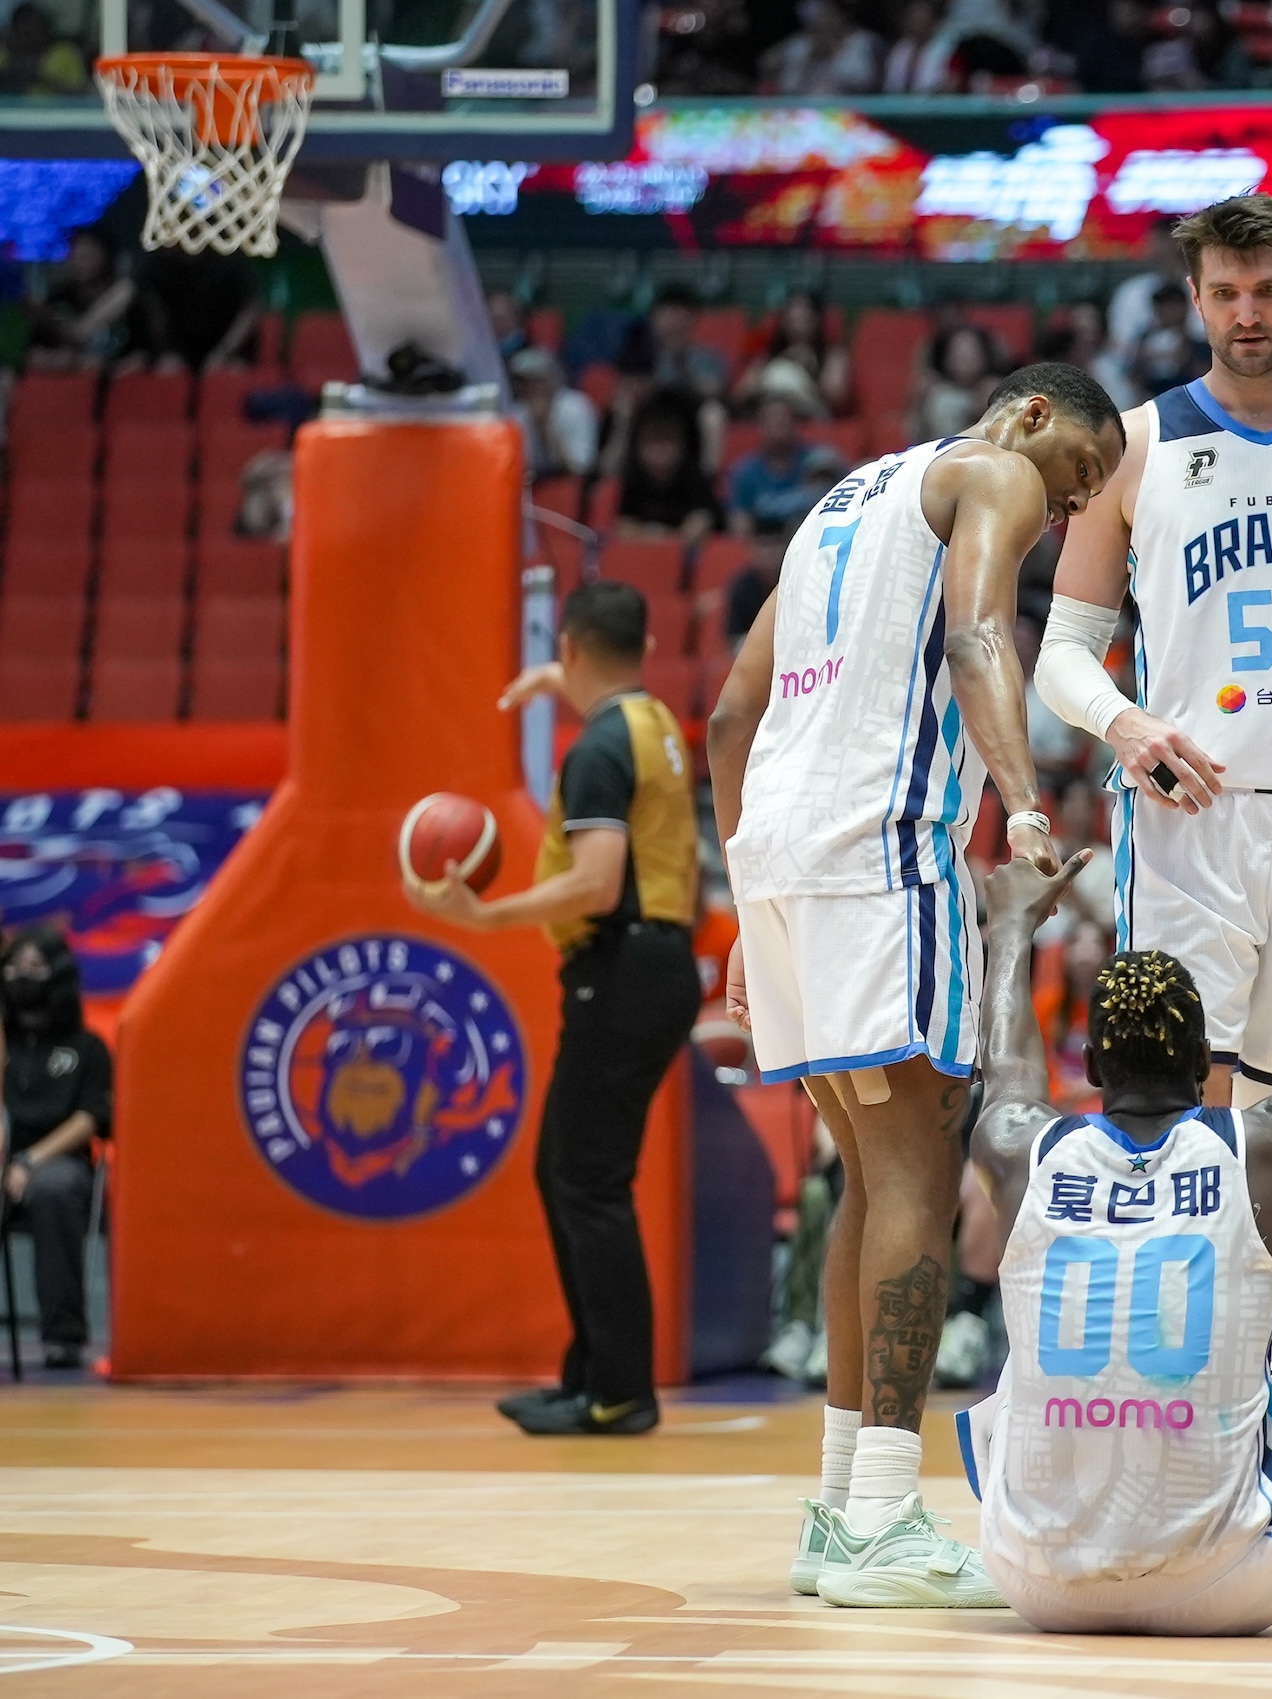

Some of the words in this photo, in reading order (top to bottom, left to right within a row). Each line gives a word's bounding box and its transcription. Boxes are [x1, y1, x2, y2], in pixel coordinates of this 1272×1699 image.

[447, 69, 562, 90] Panasonic
[818, 515, 862, 646] 7
[276, 939, 410, 1015] PILOTS
[1044, 1165, 1222, 1225] 莫巴耶
[1037, 1233, 1216, 1377] 00
[1044, 1397, 1195, 1430] momo
